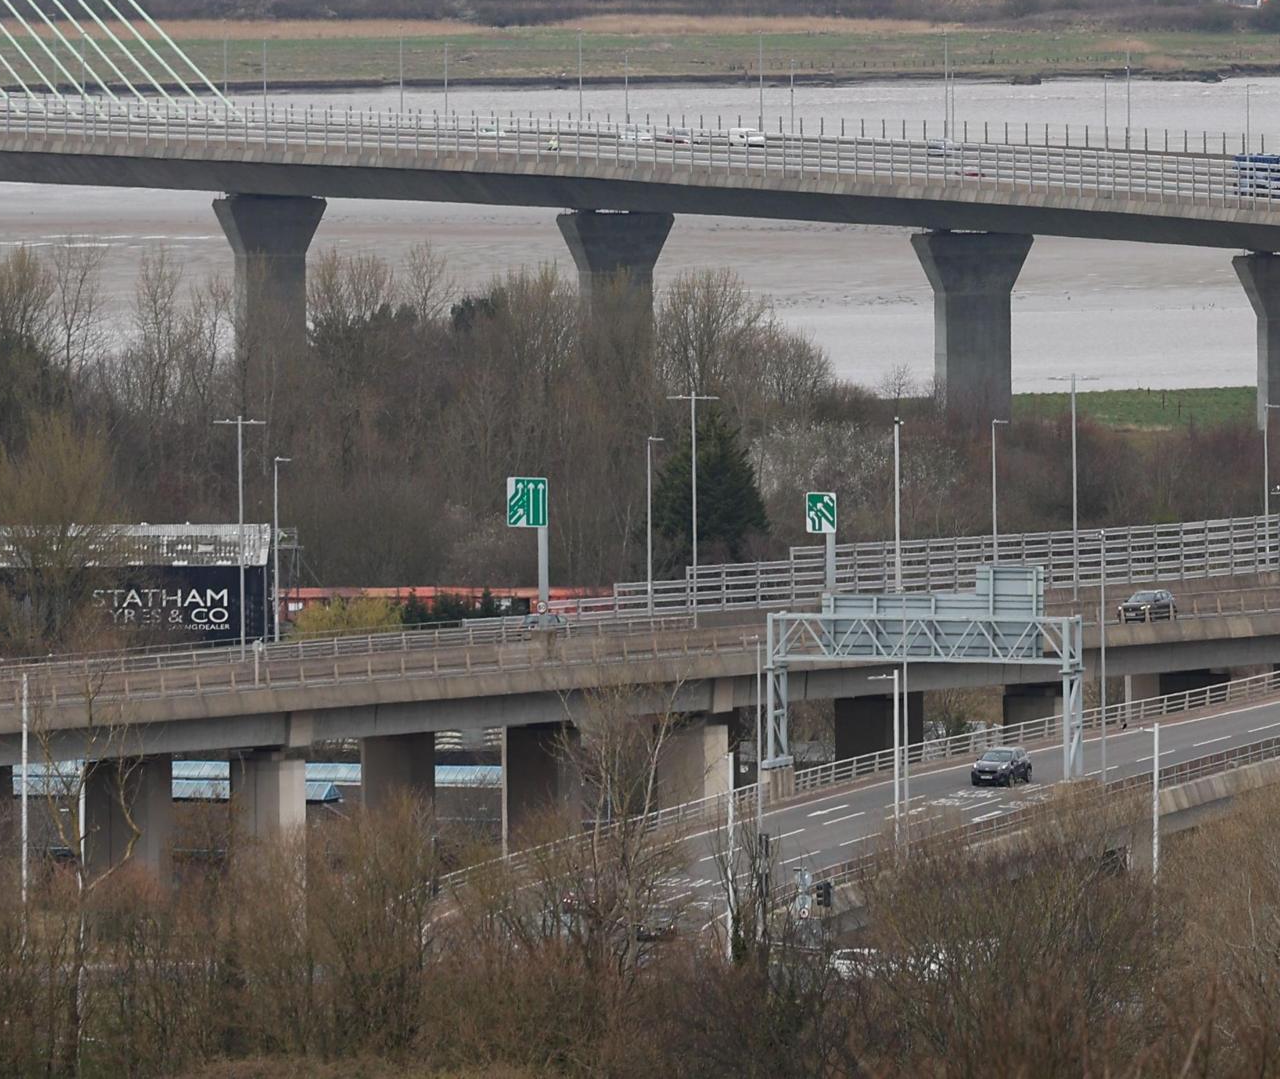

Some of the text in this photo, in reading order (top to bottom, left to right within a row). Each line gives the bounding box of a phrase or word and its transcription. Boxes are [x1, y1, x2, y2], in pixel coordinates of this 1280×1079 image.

[92, 589, 228, 607] STATHAM
[96, 607, 229, 623] YRES & CO
